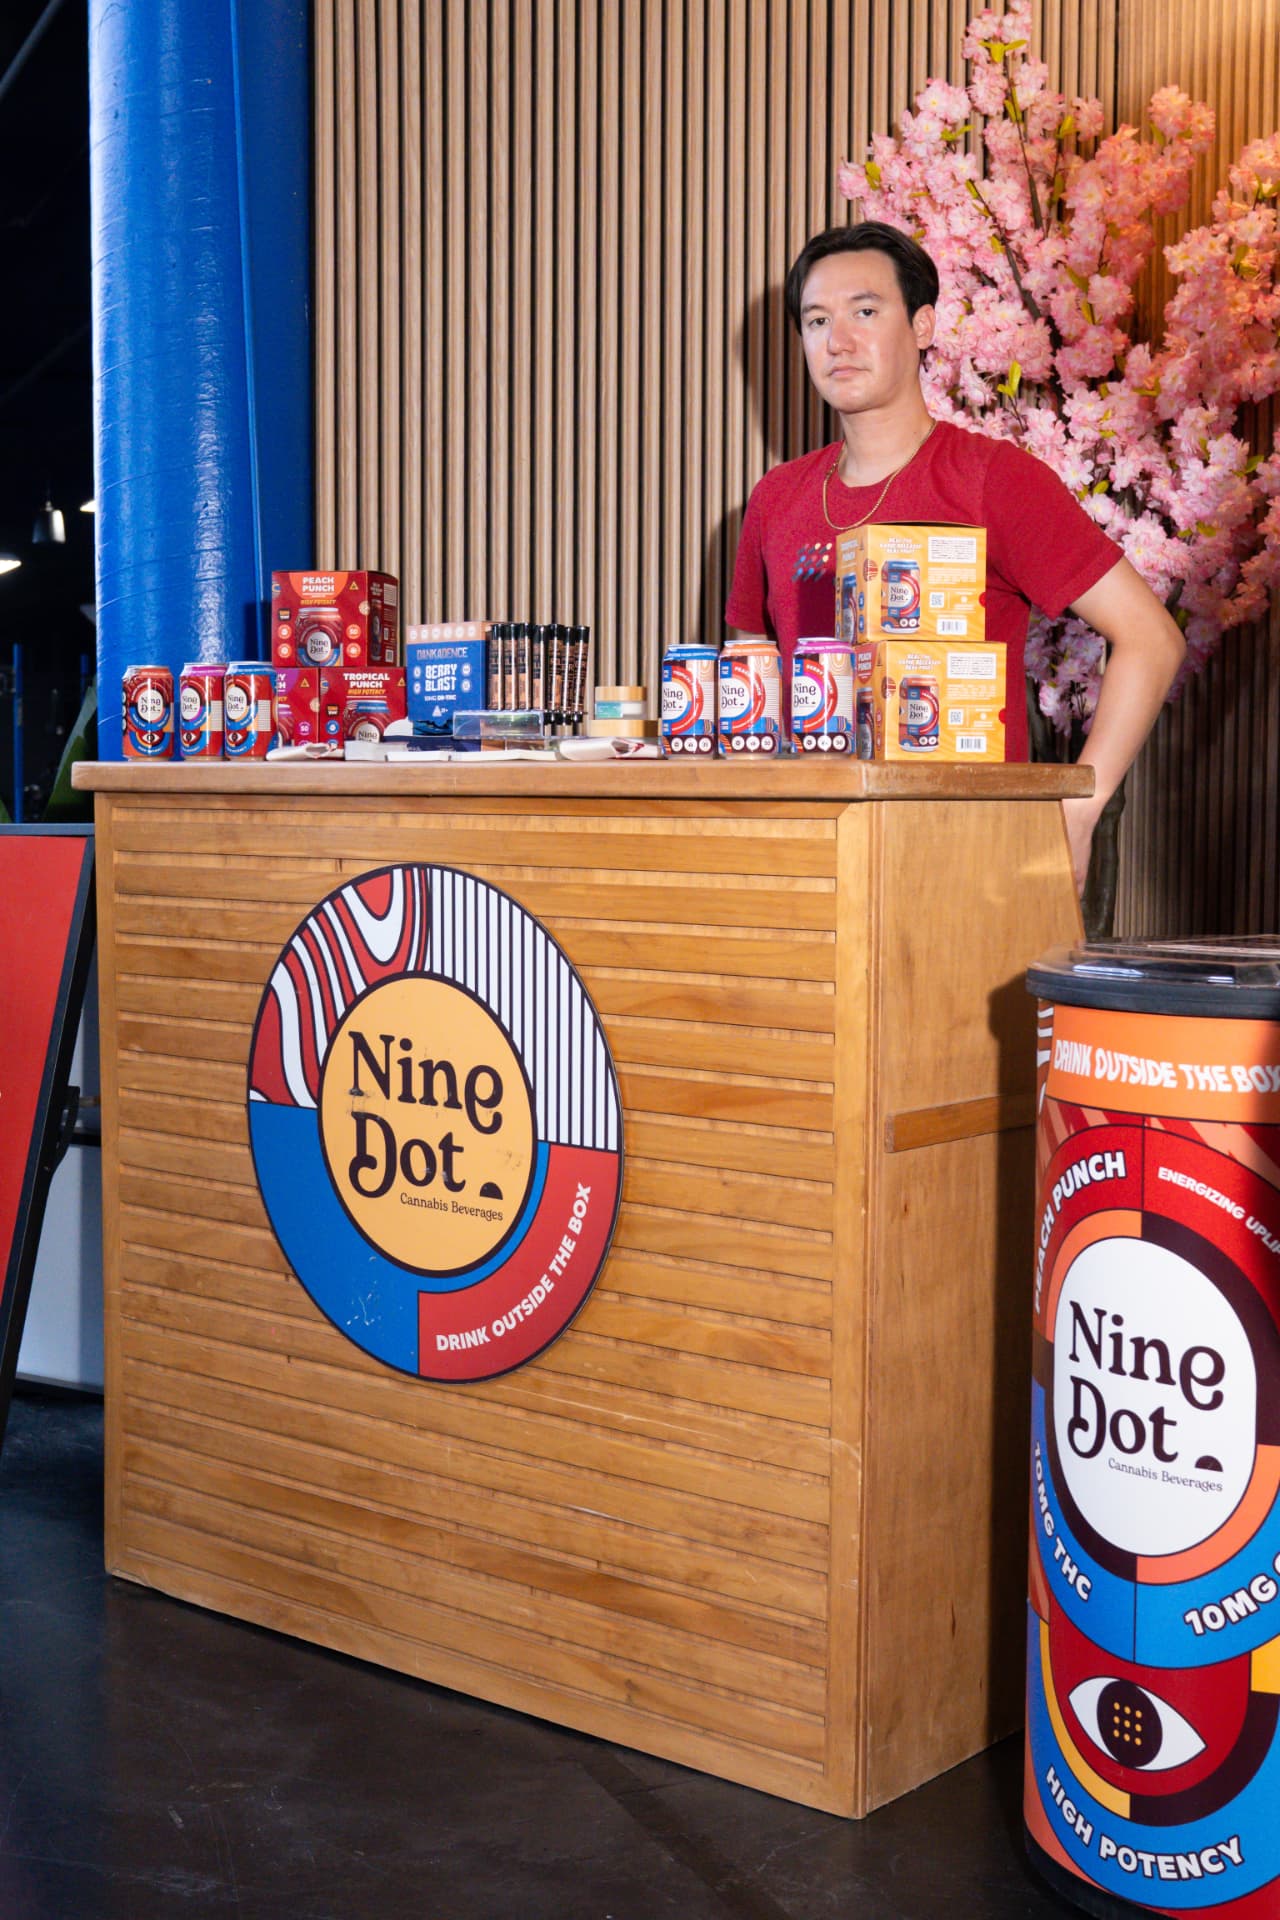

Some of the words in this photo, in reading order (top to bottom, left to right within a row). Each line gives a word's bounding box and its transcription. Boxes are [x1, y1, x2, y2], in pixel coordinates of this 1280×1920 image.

[302, 576, 335, 584] PEACH
[302, 584, 335, 592] PUNCH
[343, 672, 390, 681] TROPICAL
[416, 647, 469, 660] DANKADENCE
[425, 663, 458, 679] BERRY
[424, 677, 457, 692] BLAST
[348, 1031, 504, 1135] Nine
[1054, 1039, 1093, 1078] DRINK
[1094, 1048, 1179, 1088] OUTSIDE
[1178, 1063, 1233, 1093] THE
[400, 1192, 449, 1213] Cannabis
[451, 1201, 504, 1222] Beverages
[1052, 1150, 1127, 1212] PUNCH
[1157, 1166, 1246, 1220] ENERGIZING
[436, 1326, 491, 1352] DRINK
[491, 1275, 555, 1338] OUTSIDE
[548, 1238, 576, 1278] THE
[572, 1182, 593, 1236] BOX
[1068, 1300, 1226, 1411] Nine
[1108, 1457, 1158, 1481] Cannabis
[1161, 1470, 1224, 1493] Beverages
[1034, 1441, 1055, 1537] 10MG
[1052, 1536, 1092, 1601] THC
[1184, 1573, 1278, 1636] 10MG
[1046, 1766, 1094, 1846] HIGH
[1099, 1835, 1245, 1881] POTENCY
